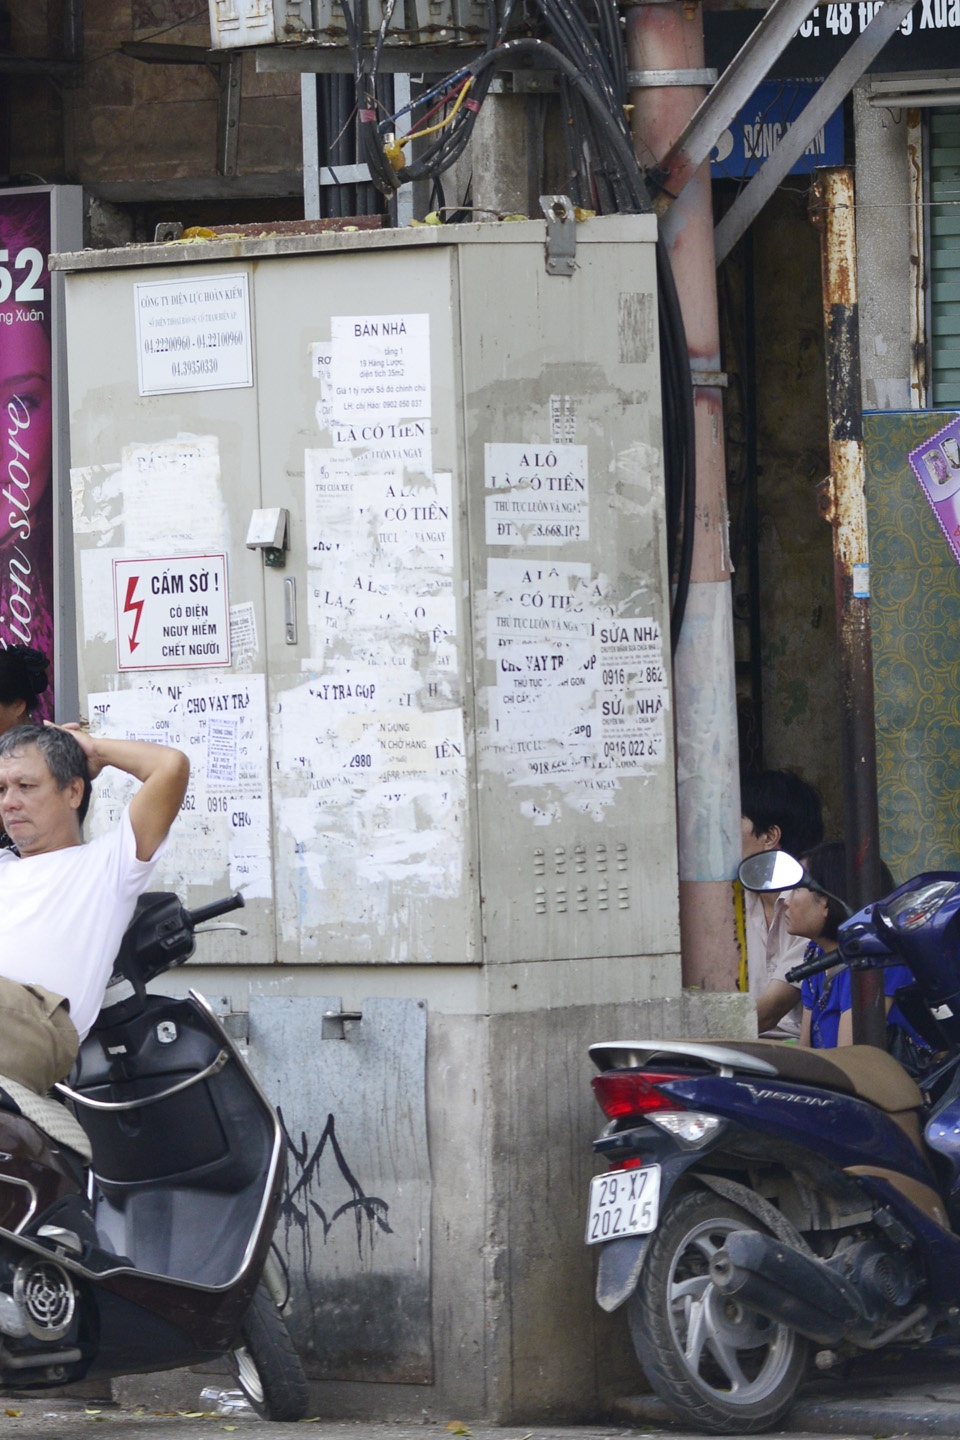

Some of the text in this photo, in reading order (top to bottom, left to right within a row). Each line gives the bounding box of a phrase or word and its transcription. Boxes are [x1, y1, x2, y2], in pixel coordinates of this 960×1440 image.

[160, 295, 169, 307] TY
[15, 307, 45, 322] Xuân
[354, 317, 407, 337] BÁN NHÀ
[144, 335, 191, 354] 04.22200960
[196, 330, 243, 349] 04.22100960
[171, 357, 219, 377] 04.39350330
[361, 422, 384, 441] CÓ
[1, 393, 32, 541] store
[519, 450, 557, 467] A LÔ
[545, 471, 585, 491] TIỀN
[385, 485, 396, 498] A
[384, 499, 449, 521] CÓ TIỀN
[150, 567, 219, 595] CẤM SỜ !
[520, 590, 544, 608] CÓ
[169, 603, 209, 621] CÓ ĐIỆN
[162, 619, 217, 638] NGUY HIỂM
[600, 621, 629, 644] SỬA
[161, 639, 220, 657] CHẾT NGƯỜI
[551, 655, 565, 671] TR
[602, 667, 625, 686] 0916
[186, 697, 207, 714] CHO
[208, 694, 229, 712] VAY
[628, 740, 645, 756] 022
[207, 796, 228, 813] 0916
[598, 1171, 649, 1208] 29-X7
[591, 1200, 652, 1240] 202.45
